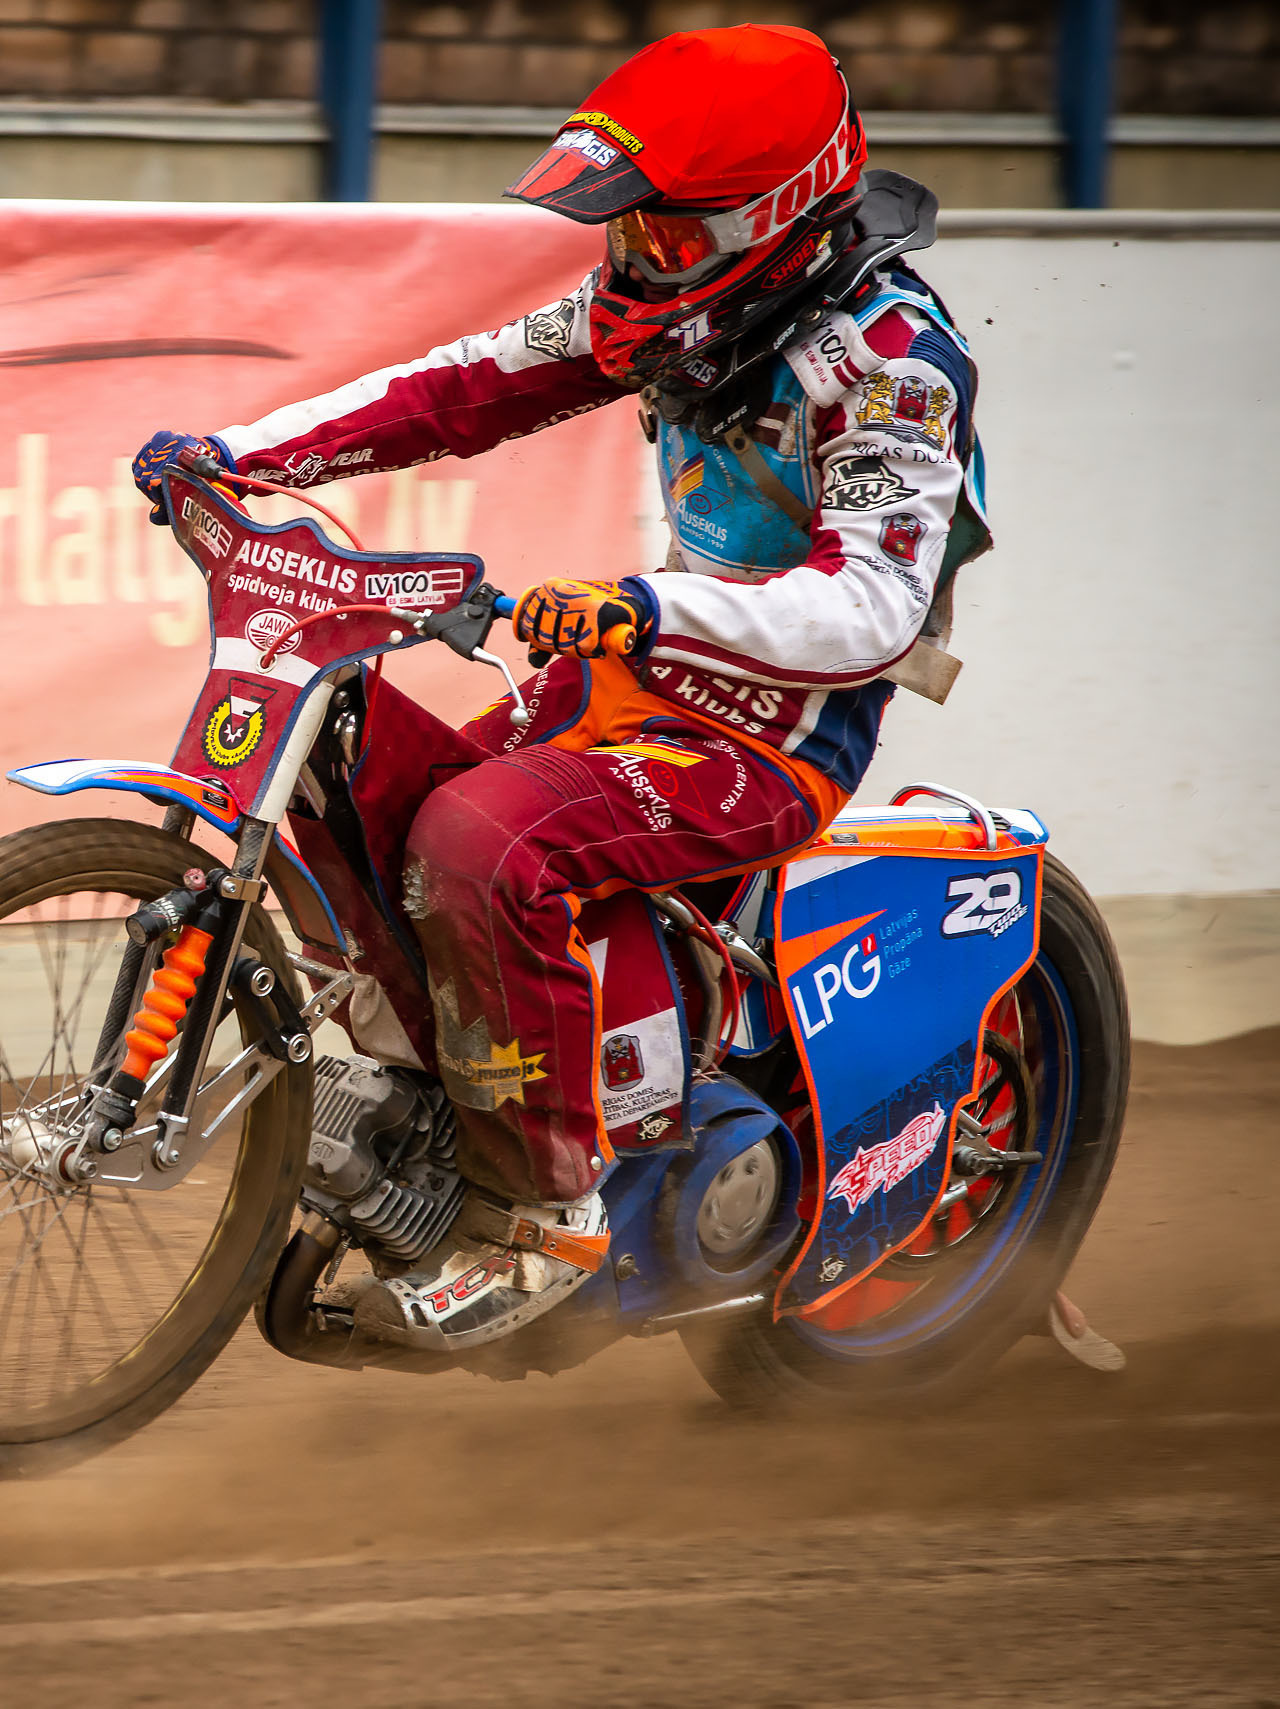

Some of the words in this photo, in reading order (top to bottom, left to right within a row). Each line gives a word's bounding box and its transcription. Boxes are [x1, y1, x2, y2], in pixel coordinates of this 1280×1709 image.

[770, 239, 816, 283] SHOEI
[228, 573, 295, 606] spīdveja
[235, 539, 358, 593] AUSEKLIS
[940, 870, 1021, 937] 29
[792, 934, 882, 1040] LPG
[849, 1124, 932, 1194] SPEED
